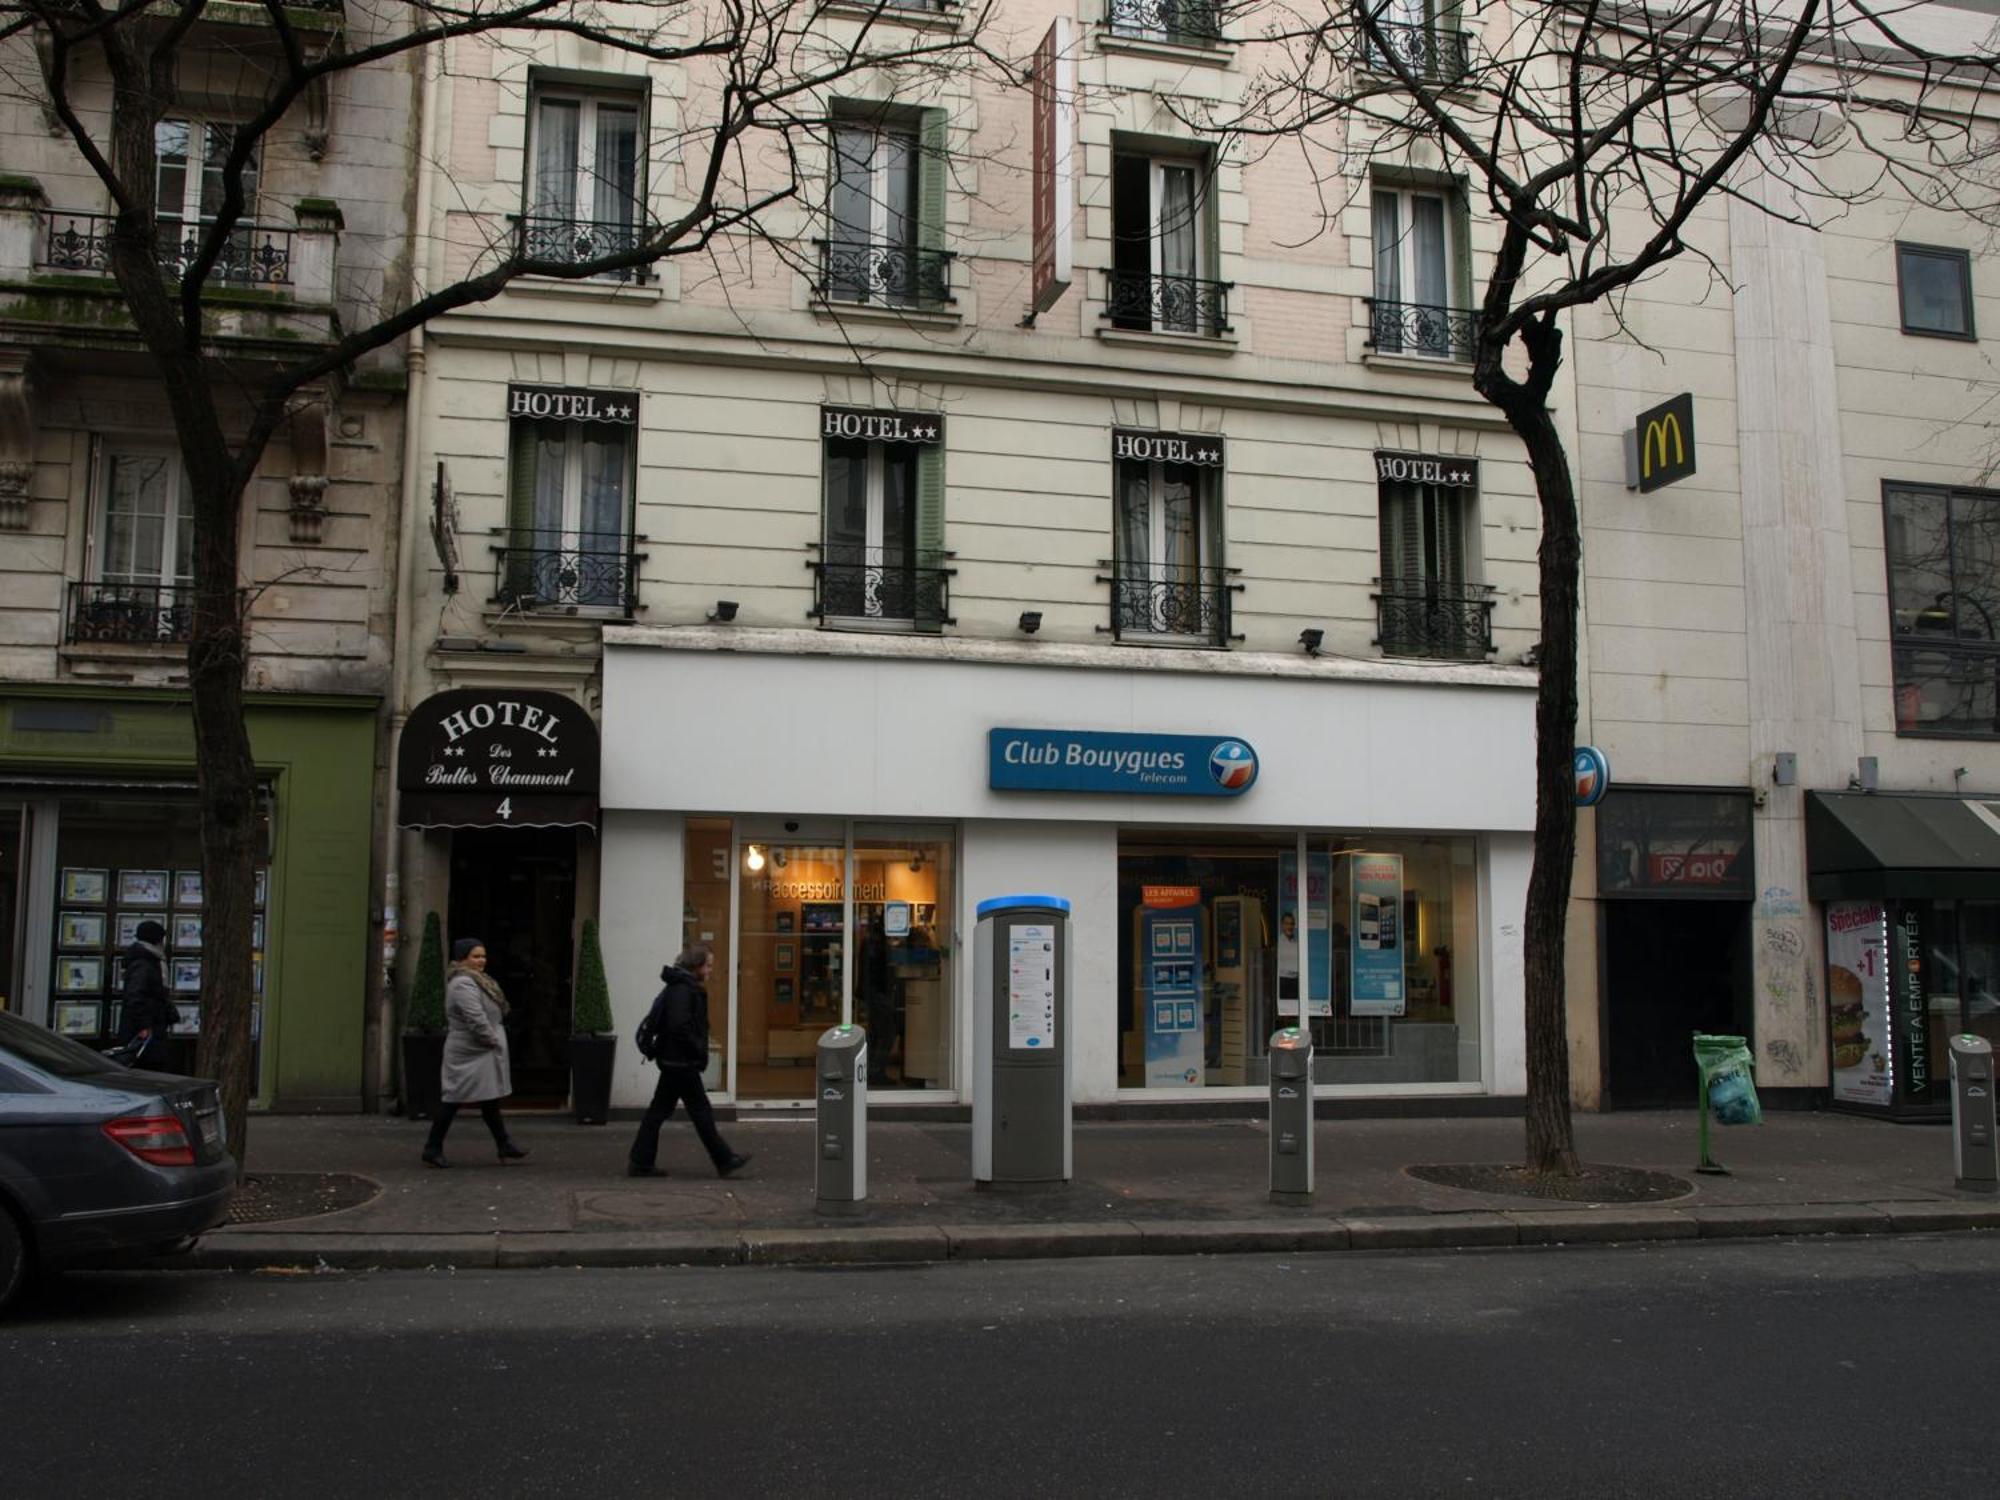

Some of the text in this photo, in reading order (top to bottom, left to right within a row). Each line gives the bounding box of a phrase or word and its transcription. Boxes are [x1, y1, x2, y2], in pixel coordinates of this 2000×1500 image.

[512, 391, 601, 418] HOTEL
[825, 412, 908, 439] HOTEL
[1116, 435, 1194, 462] HOTEL
[1378, 458, 1447, 482] HOTEL
[439, 701, 561, 743] HOTEL
[489, 743, 512, 758] Des
[1004, 740, 1185, 774] Club Bouygues
[496, 797, 513, 819] 4
[1912, 1014, 1924, 1030] A
[1911, 1032, 1928, 1091] VENTE
